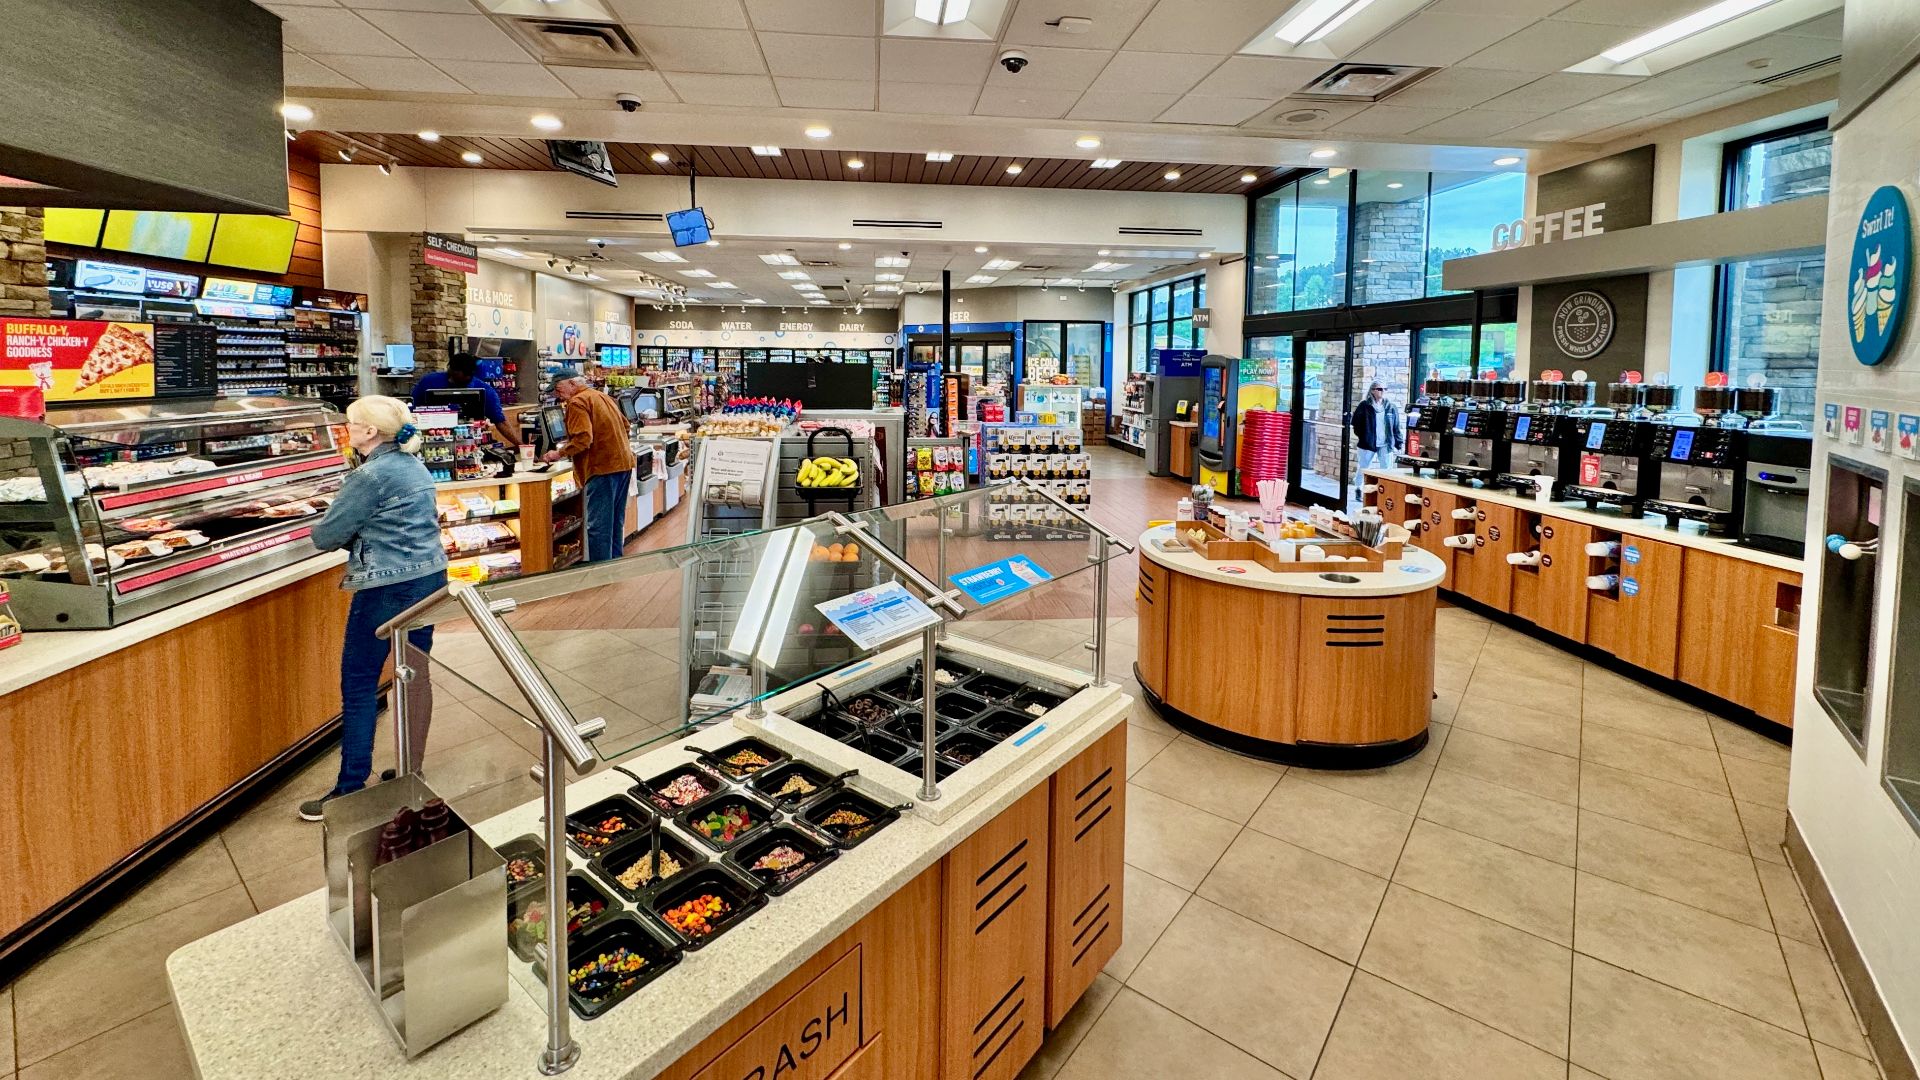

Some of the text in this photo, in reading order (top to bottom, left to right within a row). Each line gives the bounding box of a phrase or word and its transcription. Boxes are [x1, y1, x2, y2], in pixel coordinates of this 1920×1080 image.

[1492, 202, 1606, 251] COFFEE
[1862, 206, 1895, 238] Swirl It!
[469, 288, 513, 307] TEA & MORE
[1558, 296, 1607, 319] NOW GRINDING
[1193, 314, 1209, 322] ATM
[6, 323, 69, 336] BUFFALO-Y,
[669, 321, 694, 329] SODA
[721, 322, 752, 330] WATER
[780, 323, 813, 331] ENERGY
[6, 336, 89, 348] RANCH-Y, CHICKEN-Y
[1557, 323, 1608, 353] FRESH WHOLE BEANS
[6, 347, 53, 358] GOODNESS
[1027, 357, 1059, 367] ICE COLD
[958, 566, 1004, 586] STRAWBERRY
